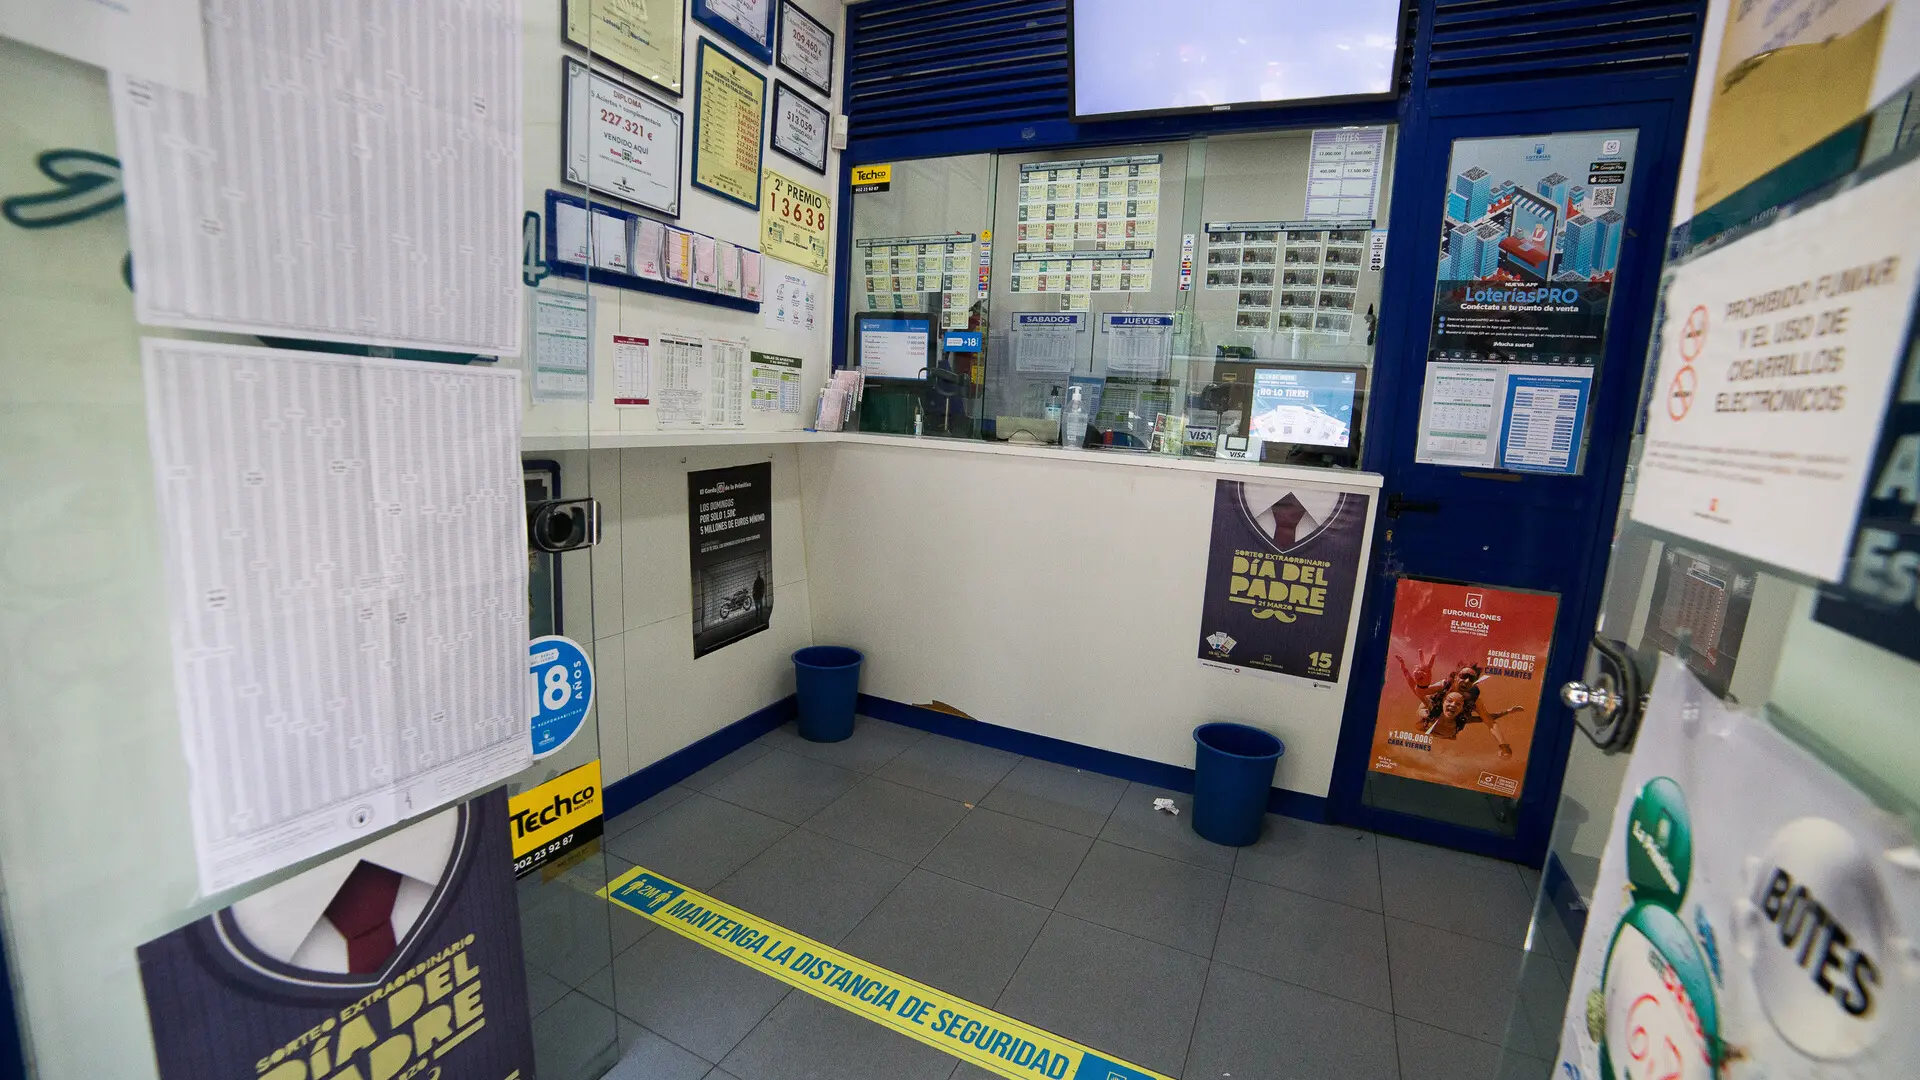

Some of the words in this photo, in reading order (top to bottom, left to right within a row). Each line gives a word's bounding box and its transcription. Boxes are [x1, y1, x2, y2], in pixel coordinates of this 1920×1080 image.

[613, 90, 642, 109] DIPLOMA
[600, 108, 644, 137] 227.321
[647, 132, 653, 141] €
[603, 131, 633, 149] VENDIDO
[634, 144, 649, 155] AQUÍ
[1336, 132, 1360, 142] BOTES
[857, 170, 886, 180] Techco
[787, 184, 822, 209] PREMIO
[771, 192, 825, 231] 13638
[1465, 287, 1579, 304] LoteríasPRO
[1725, 280, 1812, 321] PROHIBIDO
[1814, 255, 1901, 299] FUMAR
[1460, 303, 1500, 311] Conéctate
[1739, 328, 1749, 350] Y
[1752, 325, 1770, 348] EL
[1774, 315, 1815, 344] USO
[1816, 307, 1851, 337] DE
[1726, 345, 1845, 382] CIGARRILLOS
[1189, 430, 1213, 441] VISA
[1229, 451, 1246, 459] VISA
[700, 502, 709, 512] LOS
[710, 498, 734, 511] DOMINGOS
[700, 513, 709, 524] POR
[710, 511, 722, 522] SOLO
[700, 524, 704, 535] 5
[704, 521, 727, 534] MILLONES
[728, 520, 734, 529] DE
[735, 517, 749, 528] EUROS
[750, 513, 765, 524] MÍNIMO
[1235, 550, 1263, 558] SORTEO
[1265, 554, 1331, 568] EXTRAORDINARIO
[1232, 556, 1276, 578] DÍA
[1282, 563, 1328, 586] DEL
[1230, 576, 1327, 608] PADRE
[1267, 602, 1293, 610] MARZO
[1443, 609, 1501, 621] EUROMILLONES
[1461, 621, 1489, 630] MILLÓN
[1308, 651, 1333, 669] 15
[1488, 650, 1510, 658] ADEMÁS
[572, 660, 582, 700] AÑOS
[1484, 667, 1502, 676] CADA
[1504, 669, 1532, 680] MARTES
[529, 664, 572, 711] 18
[1405, 741, 1431, 751] VIERNES
[510, 786, 595, 839] Techco
[534, 848, 547, 861] 23
[548, 842, 561, 854] 92
[562, 834, 574, 846] 87
[638, 884, 658, 899] 2M
[1761, 868, 1881, 1017] BOTES
[388, 951, 480, 1030] DEL
[665, 899, 770, 954] MANTENGA
[761, 940, 797, 966] LA
[790, 952, 901, 1012] DISTANCIA
[896, 995, 936, 1026] DE
[931, 1009, 1070, 1080] SEGURIDAD
[255, 1017, 336, 1074] SORTEO
[340, 933, 475, 1022] EXTRAORDINARIO
